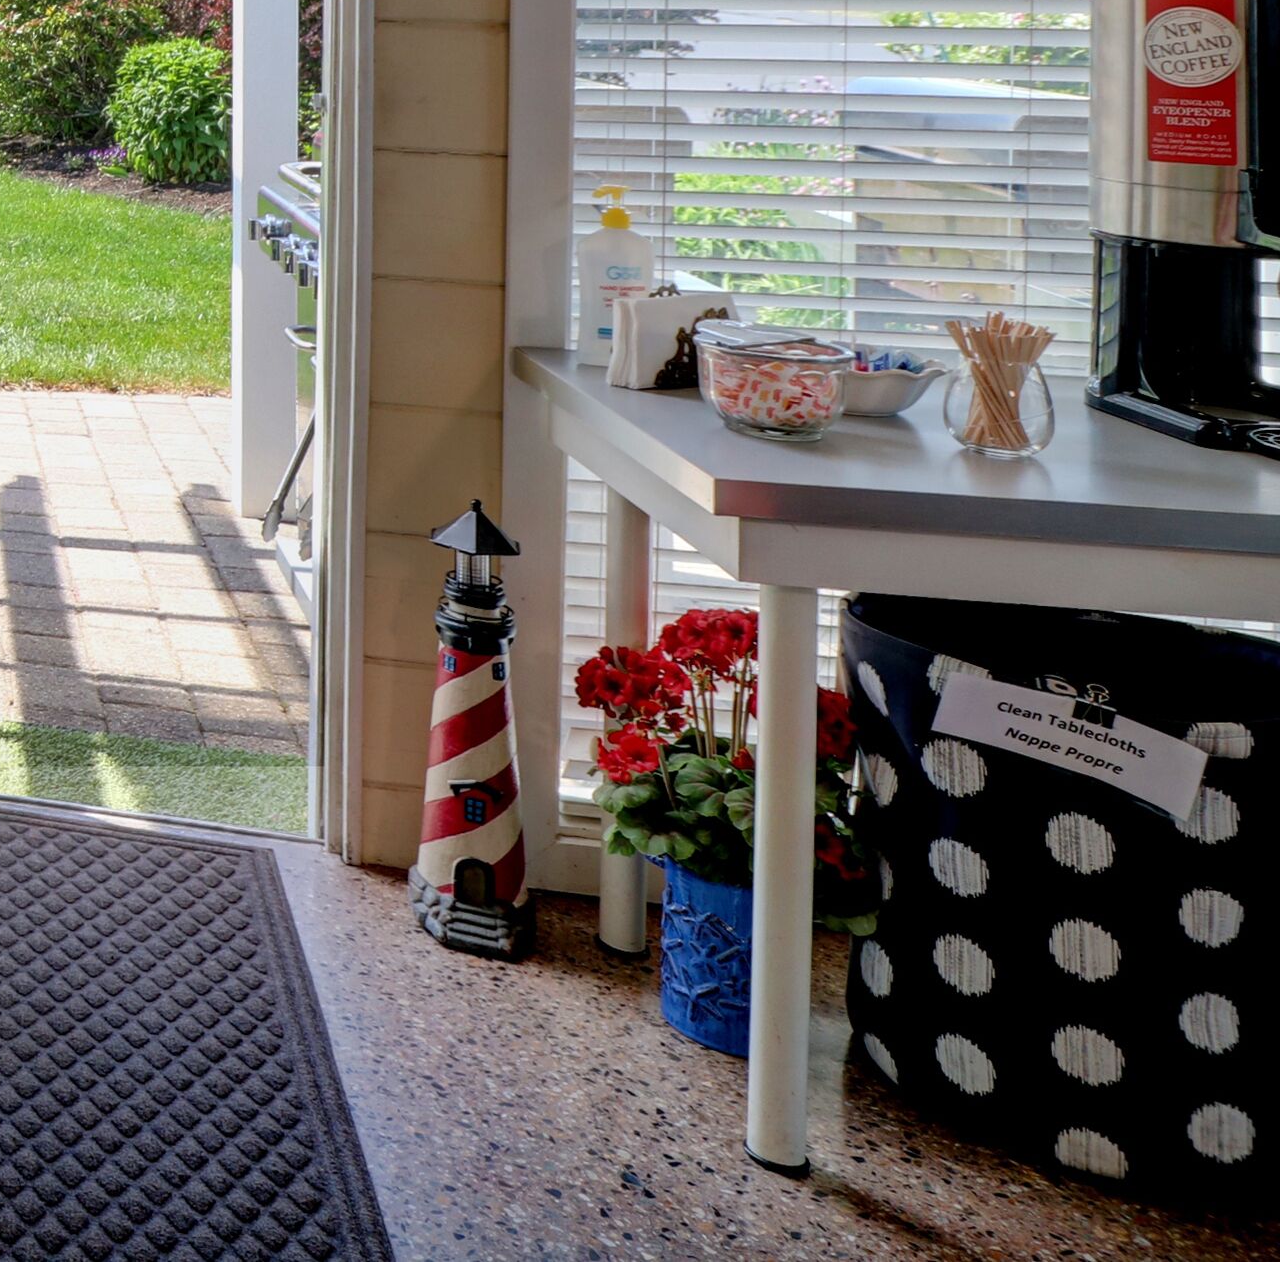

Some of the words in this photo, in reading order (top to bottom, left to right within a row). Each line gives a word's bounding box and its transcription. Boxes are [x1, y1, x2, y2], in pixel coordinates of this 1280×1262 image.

[1163, 21, 1202, 39] NEW
[1149, 35, 1233, 59] ENGLAND
[1160, 53, 1232, 75] COFFEE
[1152, 105, 1232, 118] EYEOPENER
[1158, 97, 1179, 106] NEW
[1180, 98, 1225, 108] ENGLAND
[1155, 131, 1193, 139] MEDIUM
[1196, 133, 1228, 141] ROAST
[997, 701, 1042, 722] Clean
[1048, 713, 1147, 759] Tablecloths
[1004, 726, 1061, 753] Nappe
[1065, 746, 1124, 775] Propre
